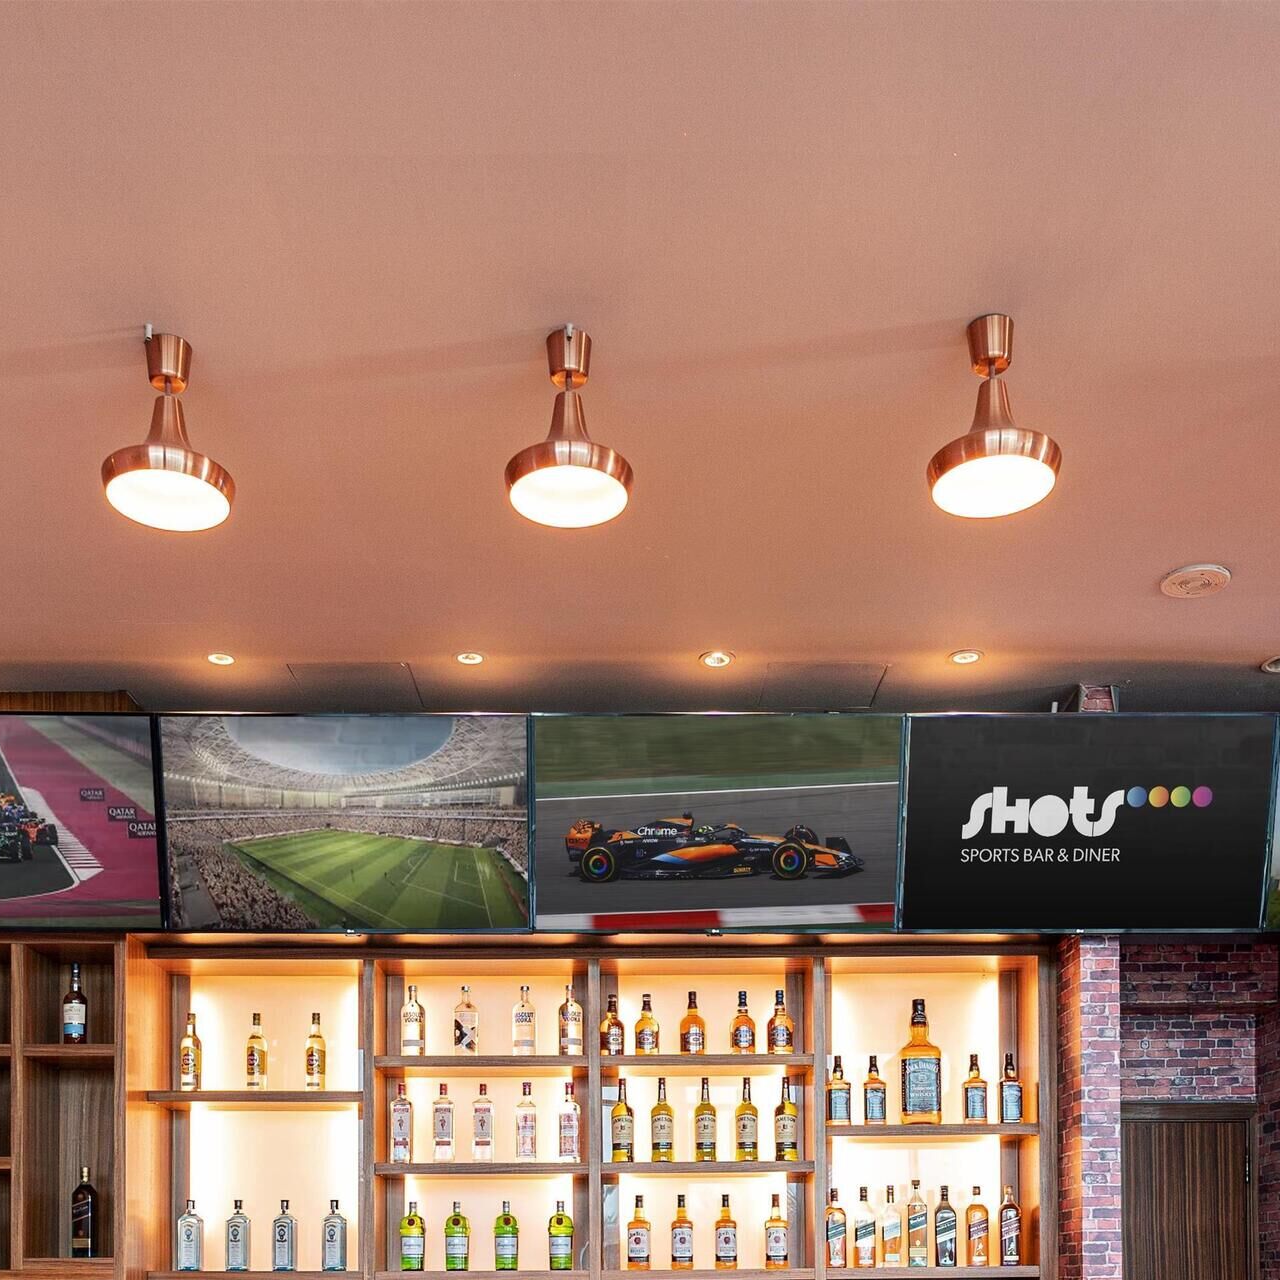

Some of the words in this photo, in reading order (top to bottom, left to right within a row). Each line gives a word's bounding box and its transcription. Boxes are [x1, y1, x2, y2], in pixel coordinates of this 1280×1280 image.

[108, 807, 136, 816] QATAR
[637, 826, 678, 836] Chrome
[960, 847, 1020, 863] SPORTS
[1023, 848, 1054, 862] BAR
[1056, 848, 1070, 862] &
[1072, 847, 1121, 862] DINER
